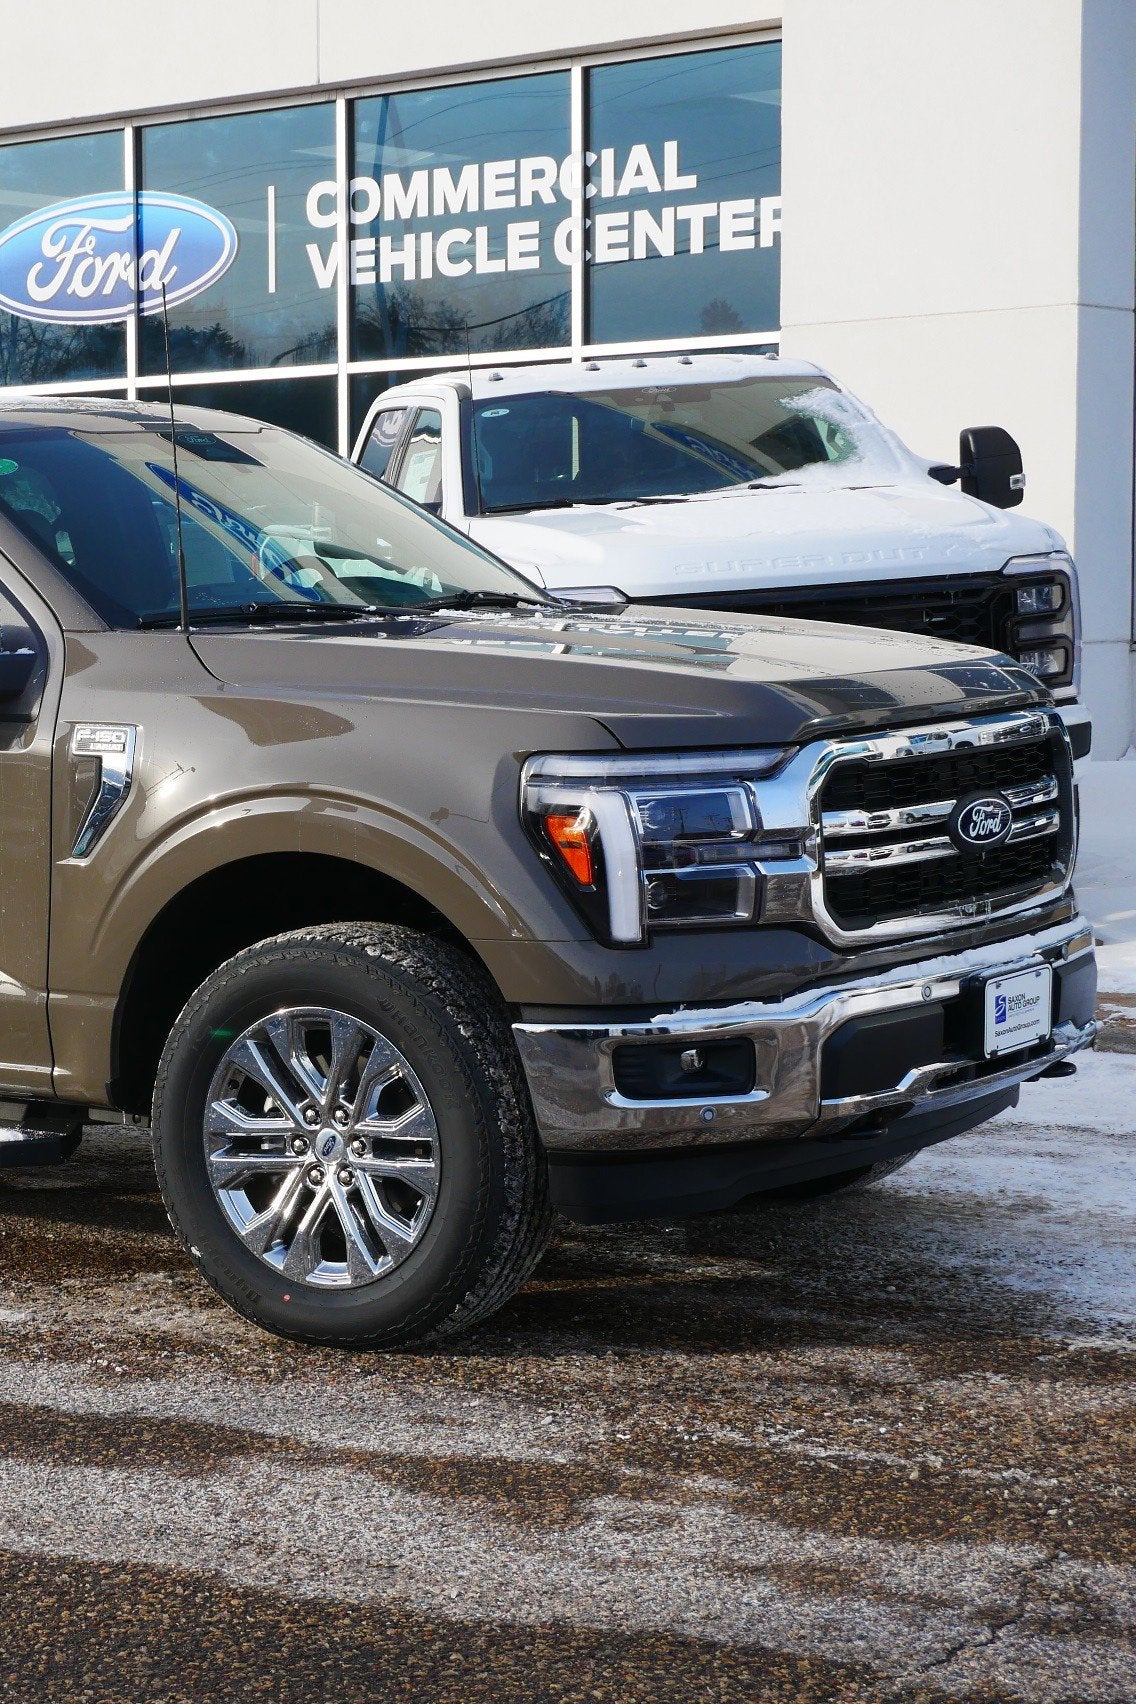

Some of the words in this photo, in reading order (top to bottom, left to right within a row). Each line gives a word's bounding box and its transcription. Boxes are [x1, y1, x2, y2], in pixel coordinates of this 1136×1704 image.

[306, 140, 698, 228] COMMERCIAL
[26, 213, 182, 302] Ford
[305, 221, 540, 289] VEHICLE
[672, 554, 834, 577] SUPER
[77, 728, 126, 743] F-150
[969, 805, 1002, 838] Ford
[1007, 993, 1026, 1005] SAXON
[1007, 1001, 1022, 1012] AUTO
[1022, 995, 1040, 1008] GROUP
